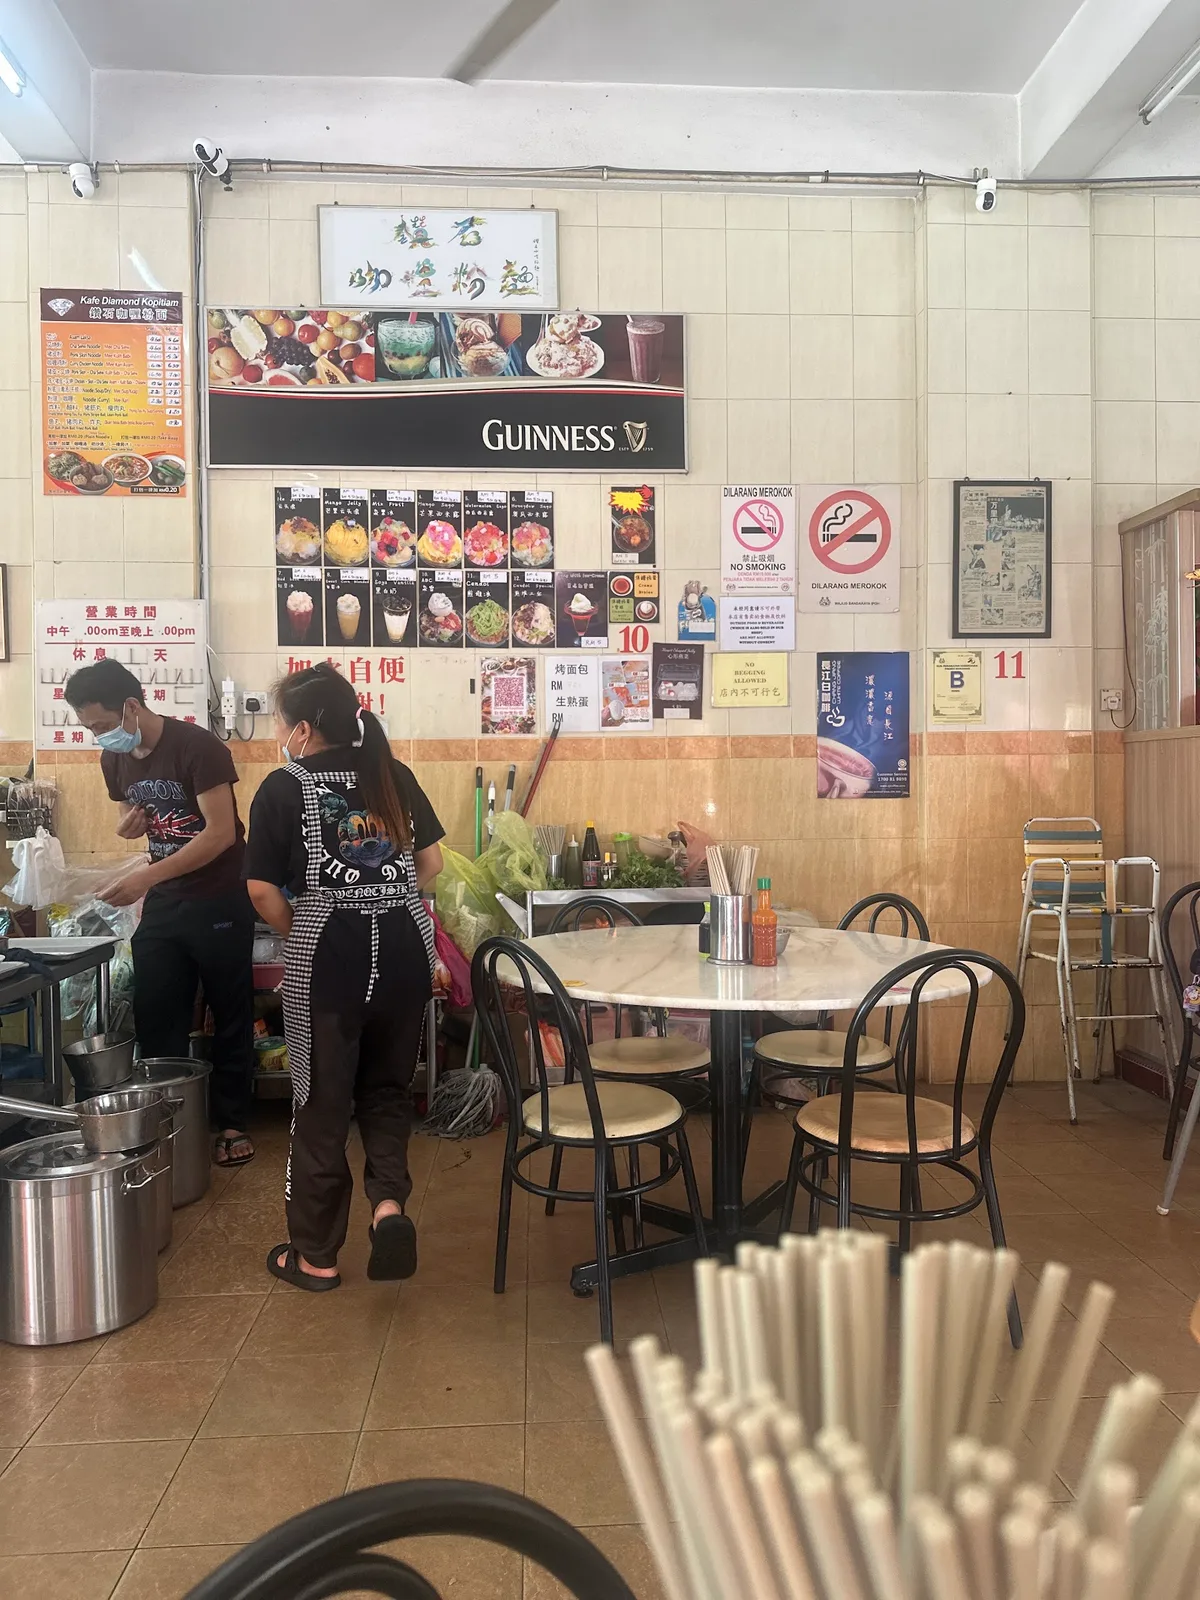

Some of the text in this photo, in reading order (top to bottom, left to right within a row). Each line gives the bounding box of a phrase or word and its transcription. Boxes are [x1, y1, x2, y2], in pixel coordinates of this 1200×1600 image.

[80, 296, 179, 307] Kafe Diamond Kopitiam
[481, 418, 616, 452] GUINNESS
[723, 487, 793, 498] DILARANG MEROKOK
[742, 554, 775, 563] 禁止吸烟
[730, 563, 787, 571] NO SMOKING
[811, 582, 887, 590] DILARANG MEROKOK
[86, 605, 157, 618] 營業時間
[46, 625, 70, 637] 中午
[161, 626, 196, 638] .00pm
[619, 624, 650, 653] 10
[154, 648, 167, 662] 天
[555, 664, 588, 675] 烤面包
[993, 650, 1026, 679] 11
[551, 680, 563, 690] RM
[950, 671, 965, 689] B
[555, 696, 589, 707] 生熟蛋
[552, 712, 564, 723] RM
[53, 731, 84, 743] 星期
